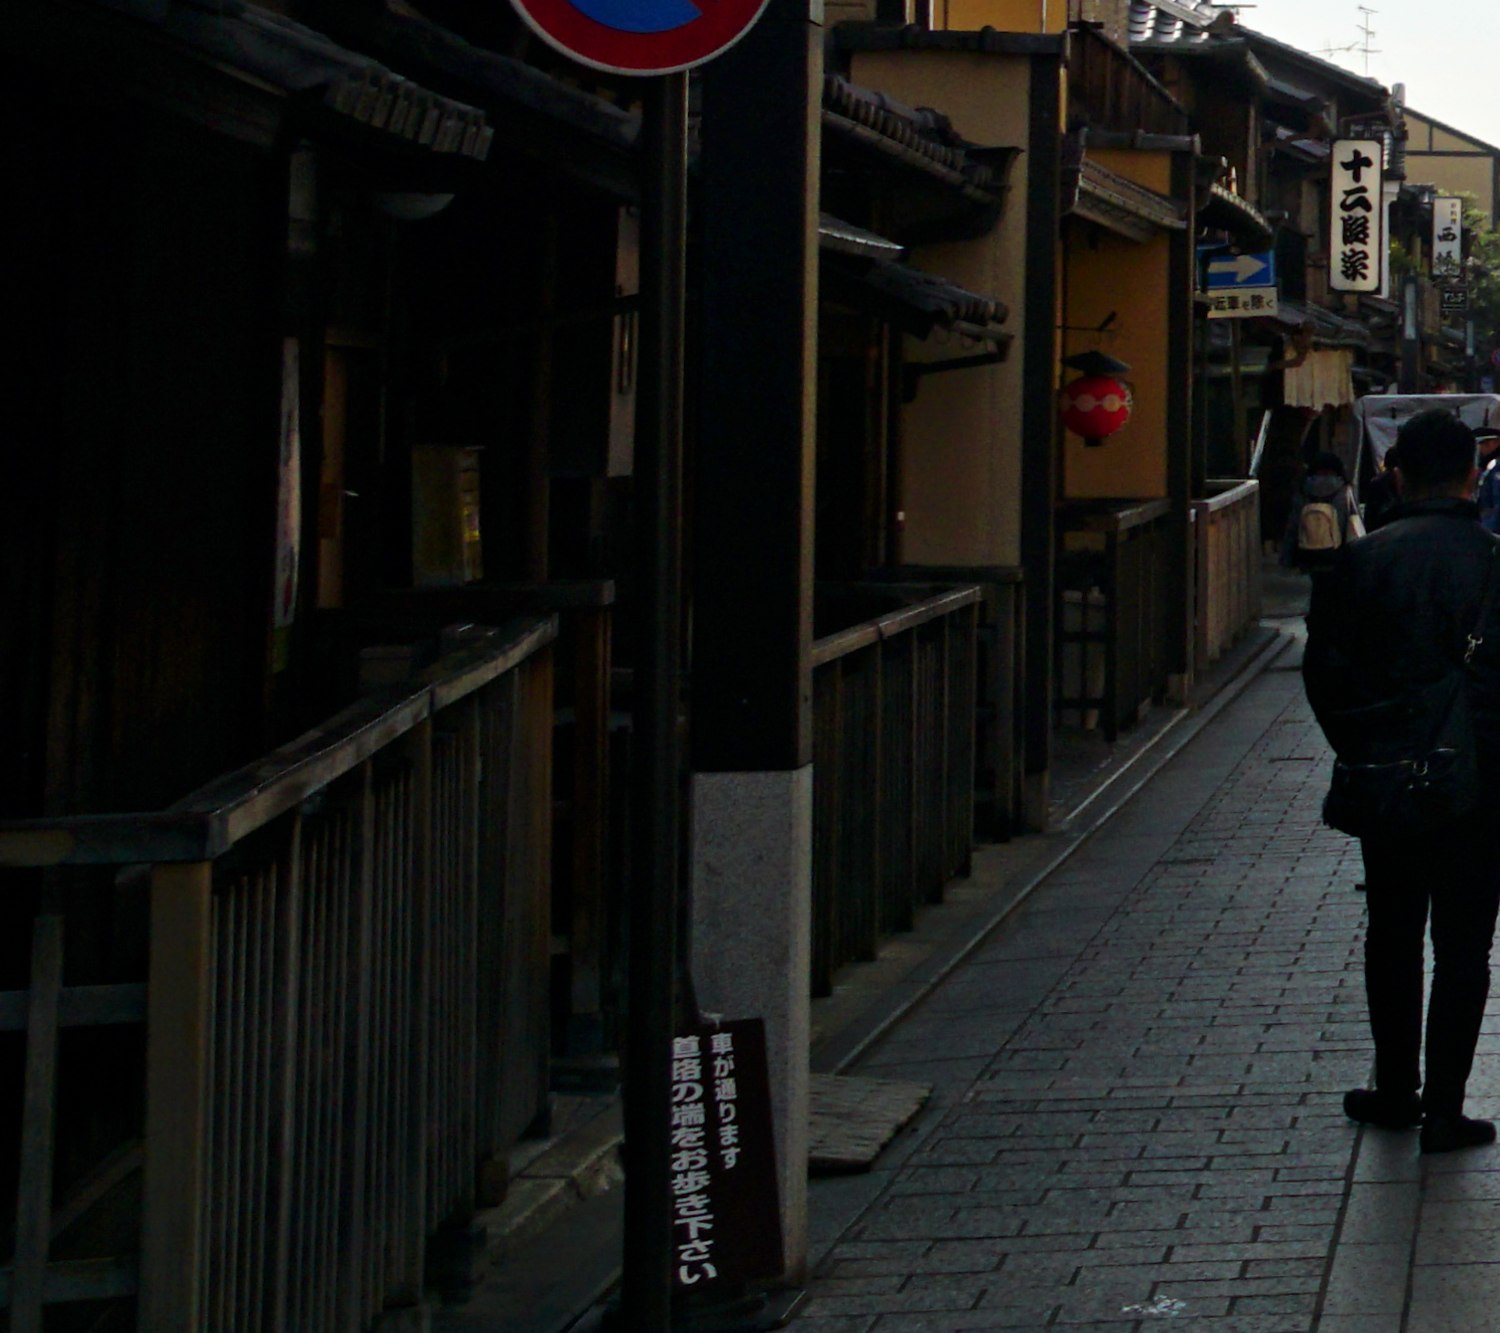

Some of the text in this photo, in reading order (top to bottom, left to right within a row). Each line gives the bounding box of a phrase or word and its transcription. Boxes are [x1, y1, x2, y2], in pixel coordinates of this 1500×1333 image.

[1340, 148, 1374, 283] 十二段家
[671, 1034, 718, 1286] 道路の端をお歩き下さい
[710, 1032, 740, 1171] 車が通ります
